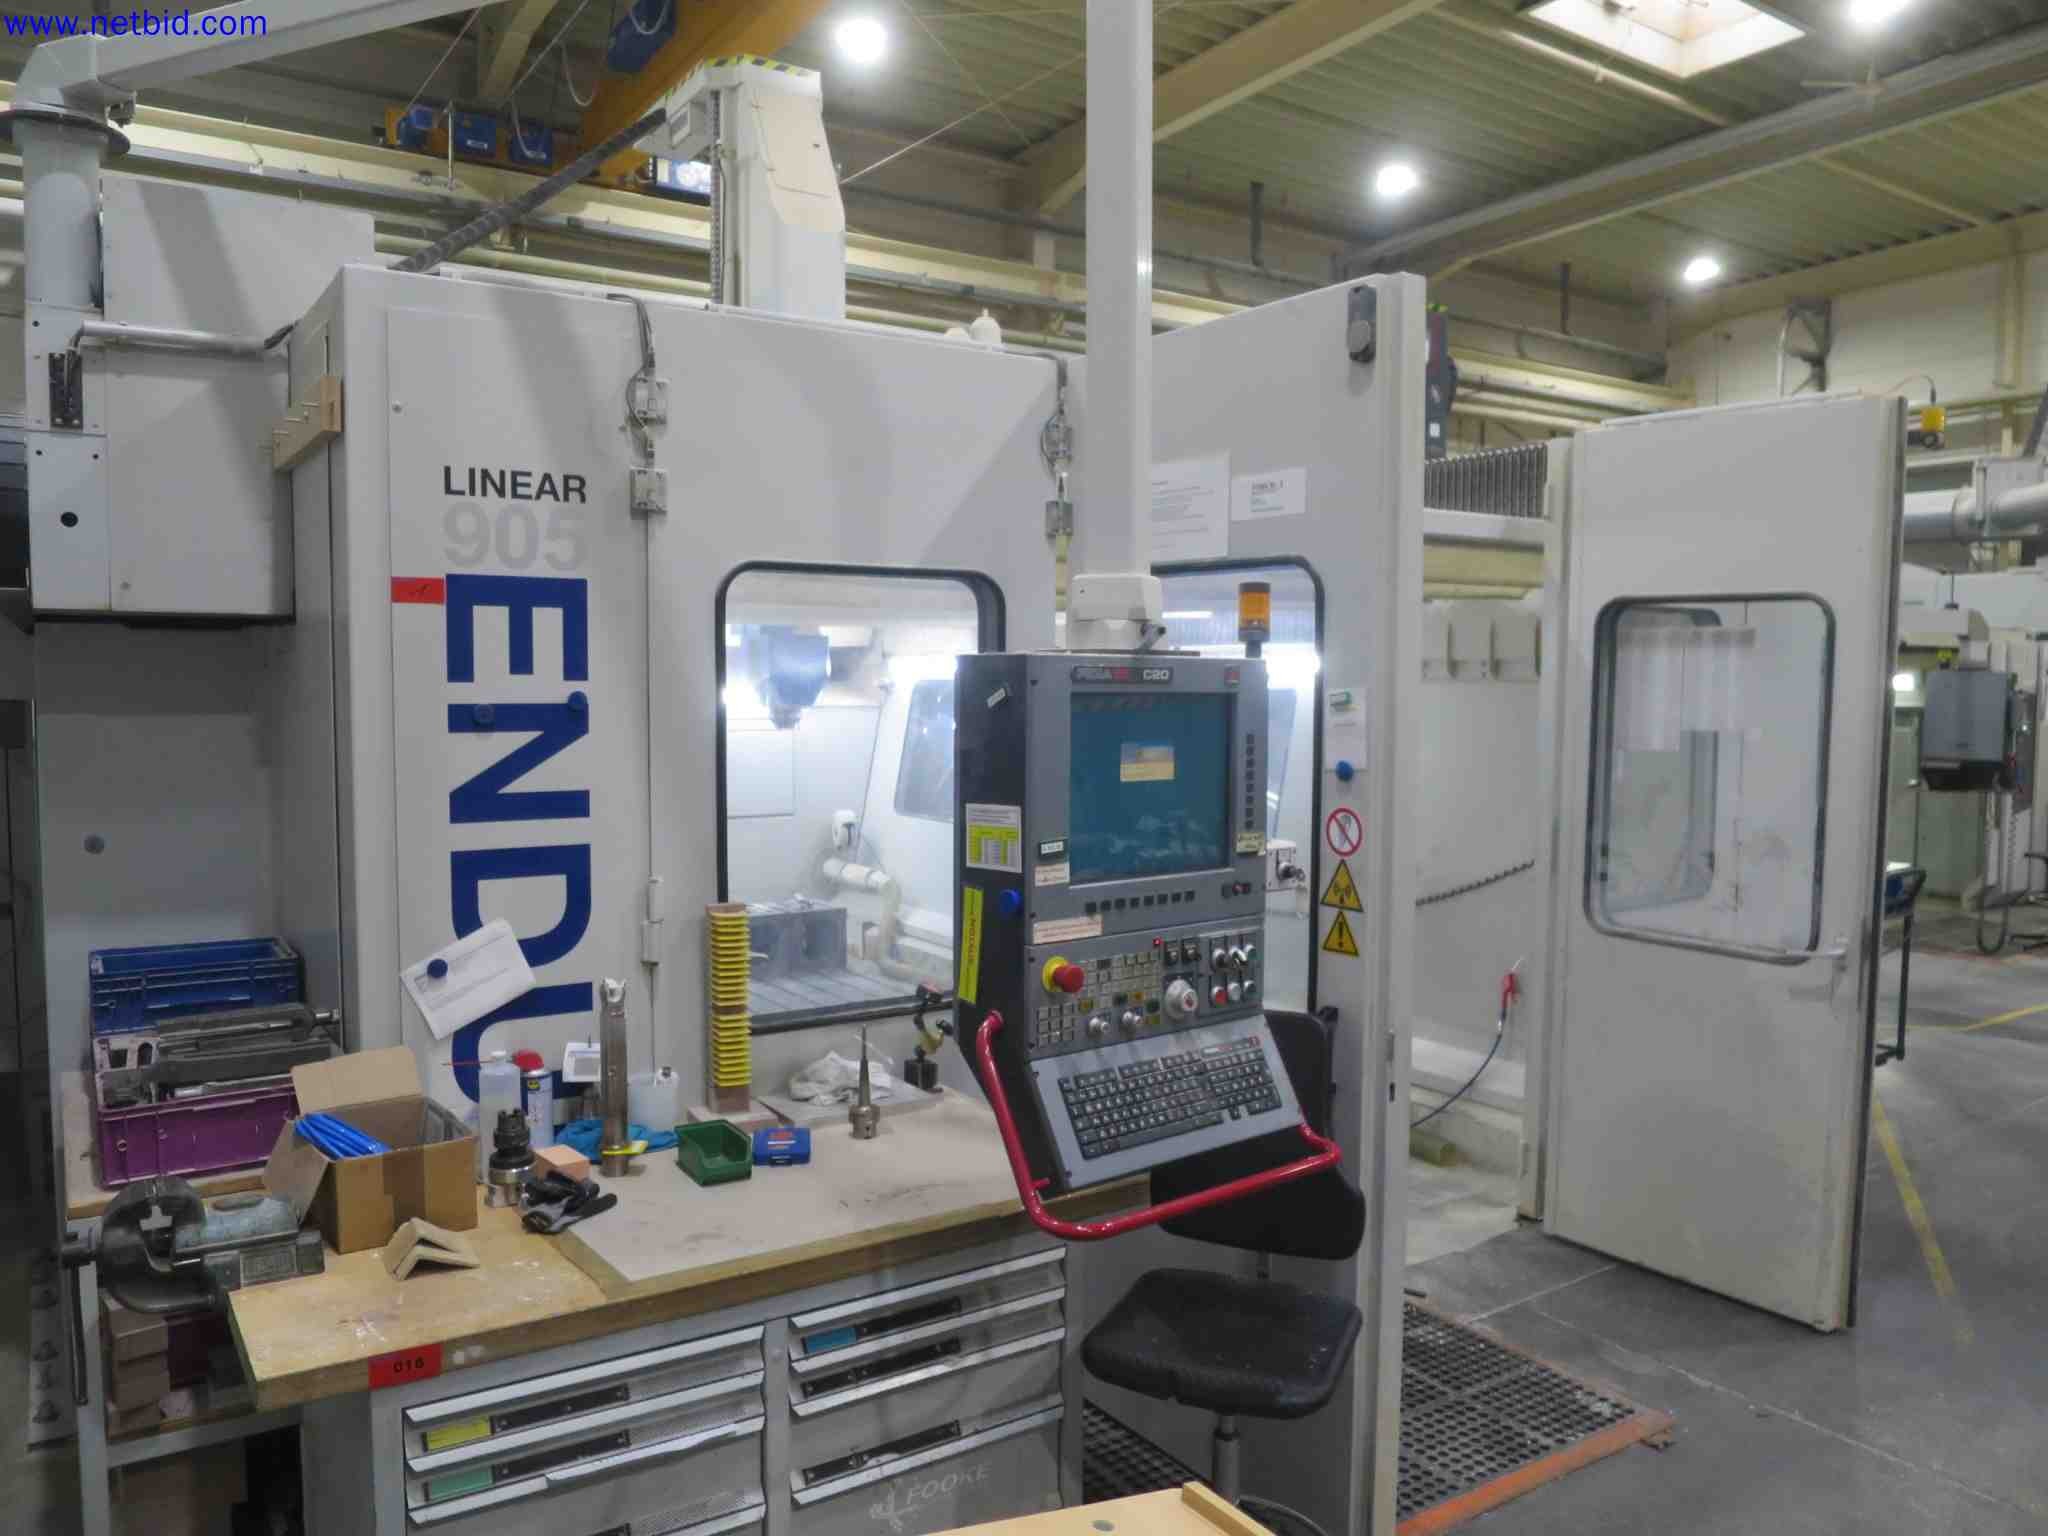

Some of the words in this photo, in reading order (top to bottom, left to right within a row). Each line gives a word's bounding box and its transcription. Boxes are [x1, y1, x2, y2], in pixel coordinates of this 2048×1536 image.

[444, 465, 586, 503] LINEAR
[443, 501, 587, 571] 905
[1143, 669, 1169, 680] C20
[908, 1464, 990, 1504] FOOKE
